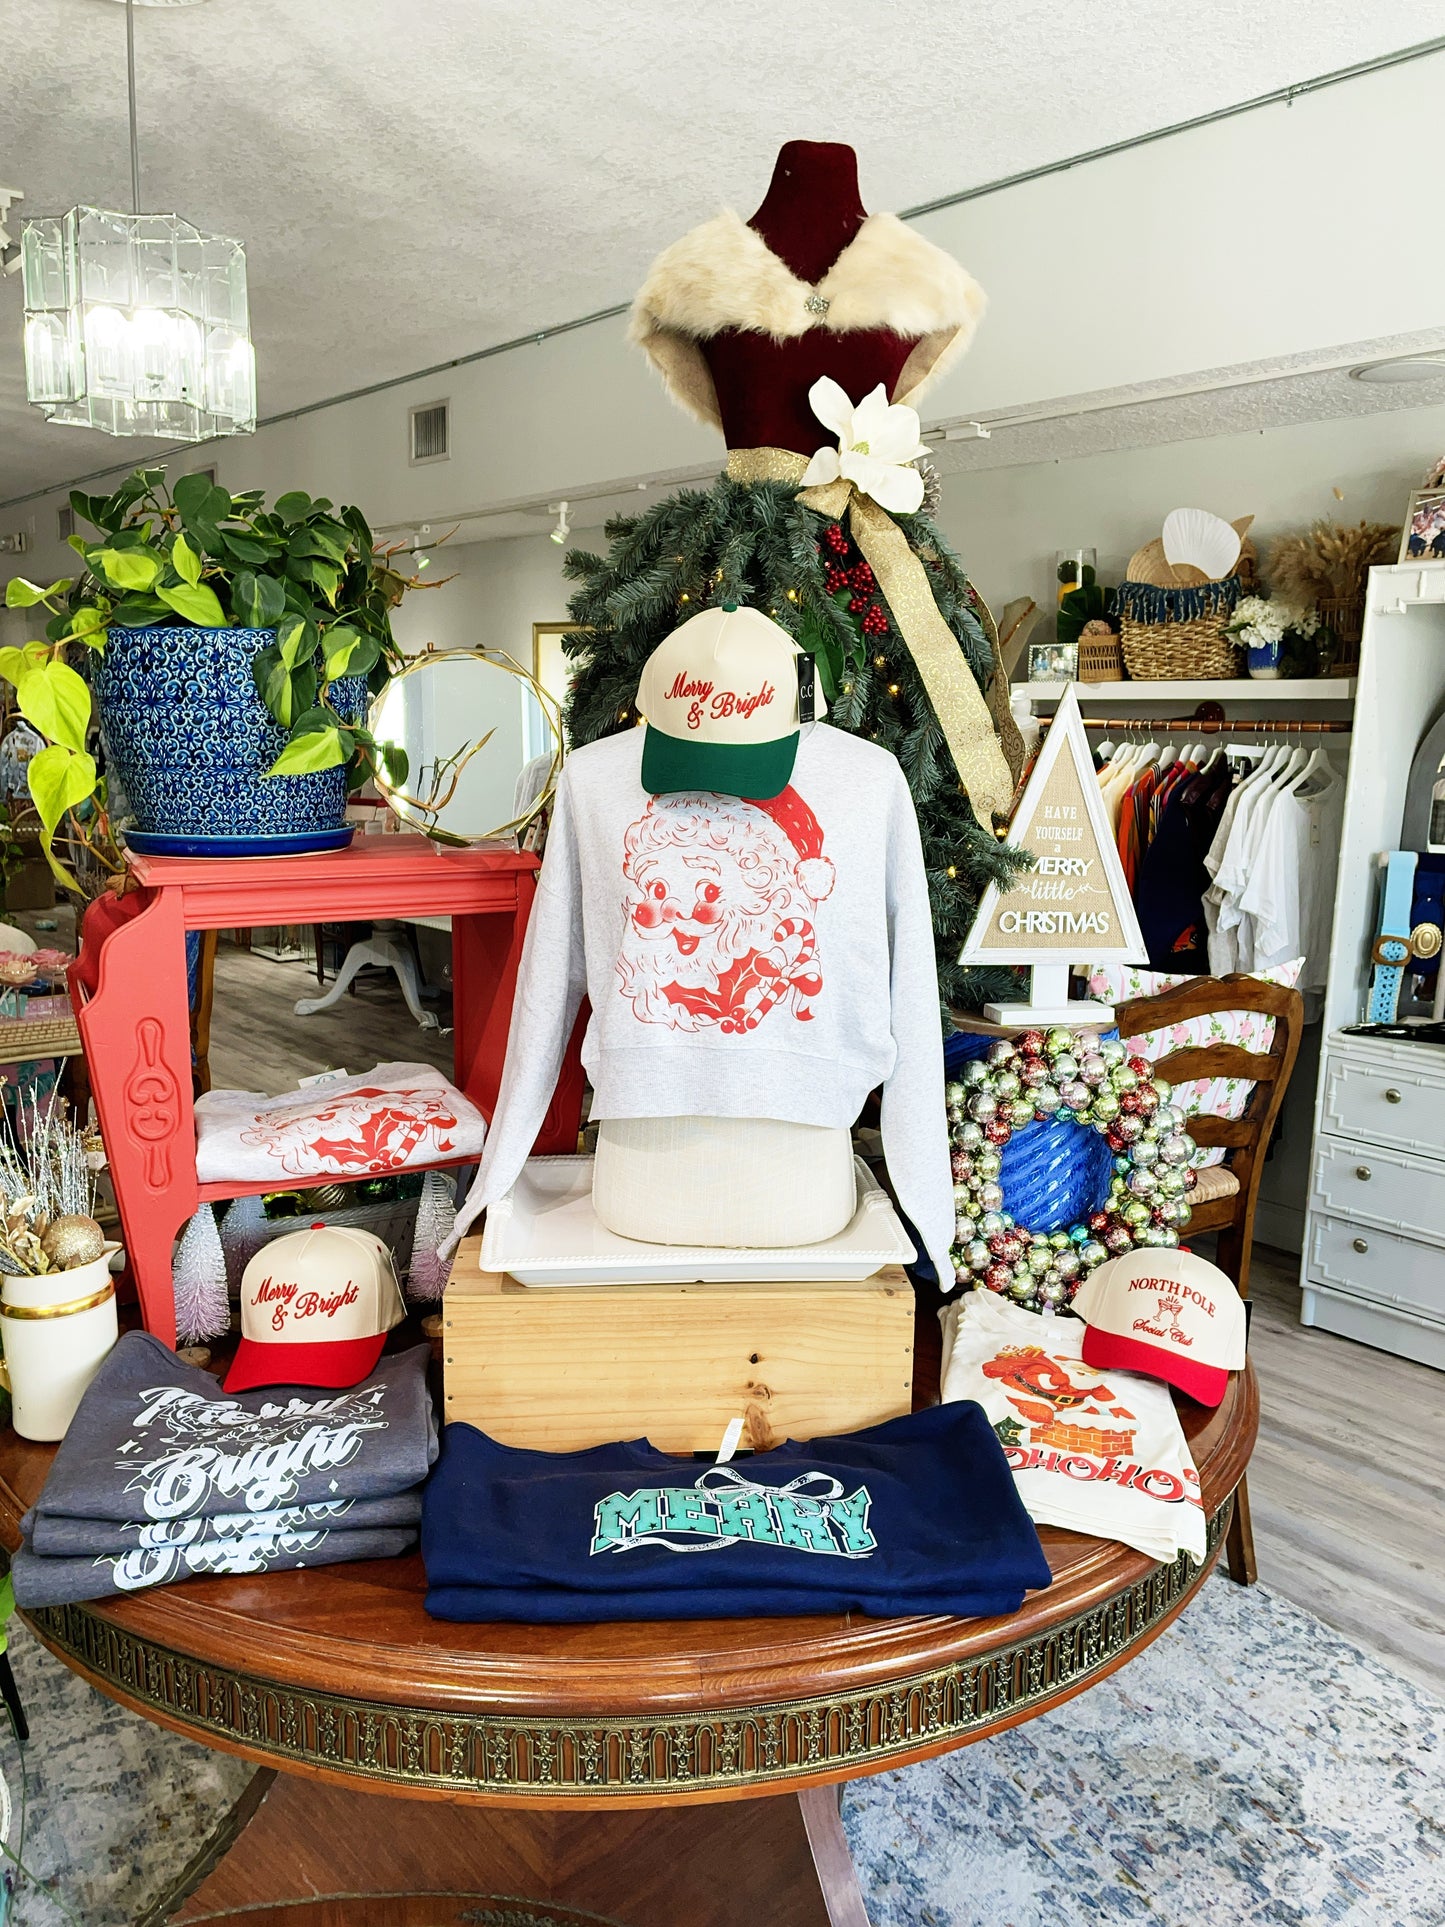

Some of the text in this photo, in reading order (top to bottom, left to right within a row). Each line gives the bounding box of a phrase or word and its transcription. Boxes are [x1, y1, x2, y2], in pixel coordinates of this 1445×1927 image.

[664, 671, 715, 704] Merry
[687, 680, 776, 730] & Bright
[1044, 805, 1077, 820] HAVE
[1035, 826, 1084, 842] YOURSELF
[1053, 843, 1062, 854] a
[1031, 879, 1078, 901] little
[999, 910, 1110, 935] CHRISTMAS
[250, 1275, 299, 1306] Merry
[272, 1279, 360, 1332] & Bright
[1127, 1277, 1217, 1319] NORTH POLE
[1132, 1318, 1194, 1347] Social Club
[141, 1421, 390, 1520] Bright
[589, 1484, 878, 1557] MERRY
